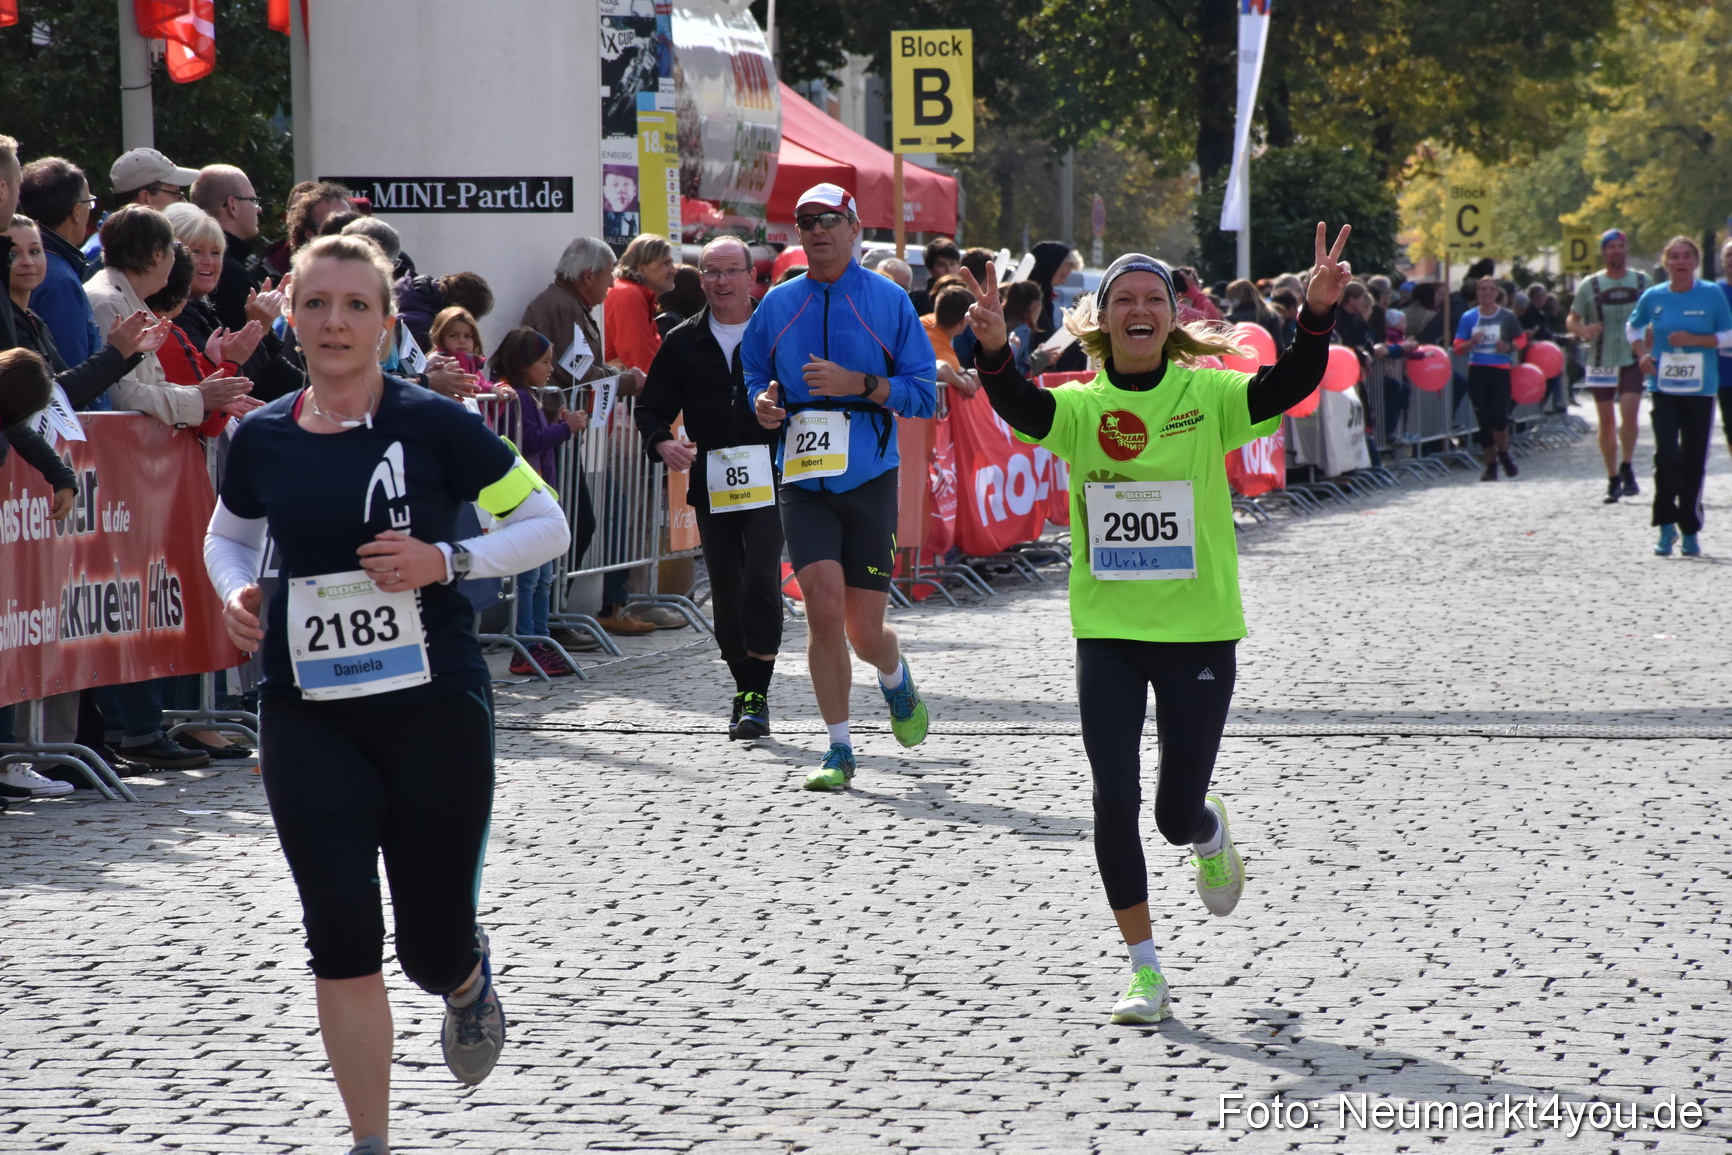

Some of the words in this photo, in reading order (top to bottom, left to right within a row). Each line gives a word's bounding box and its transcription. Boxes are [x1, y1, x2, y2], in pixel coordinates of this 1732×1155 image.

[618, 32, 634, 46] CUP
[901, 35, 963, 57] Block
[913, 68, 953, 126] B
[641, 130, 664, 153] 18.
[1451, 187, 1486, 199] Block
[1457, 204, 1479, 237] C
[1571, 238, 1588, 262] D
[1664, 365, 1696, 378] 2367
[796, 431, 831, 455] 224
[801, 458, 823, 468] Robert
[726, 466, 750, 487] 85
[729, 491, 751, 501] Harald
[1126, 490, 1162, 499] BOCK
[113, 501, 130, 532] die
[1103, 511, 1179, 541] 2905
[1100, 550, 1160, 568] Ulrike
[147, 557, 184, 629] Hits
[327, 580, 375, 598] BOCK
[305, 605, 399, 652] 2183
[333, 659, 383, 677] Daniela
